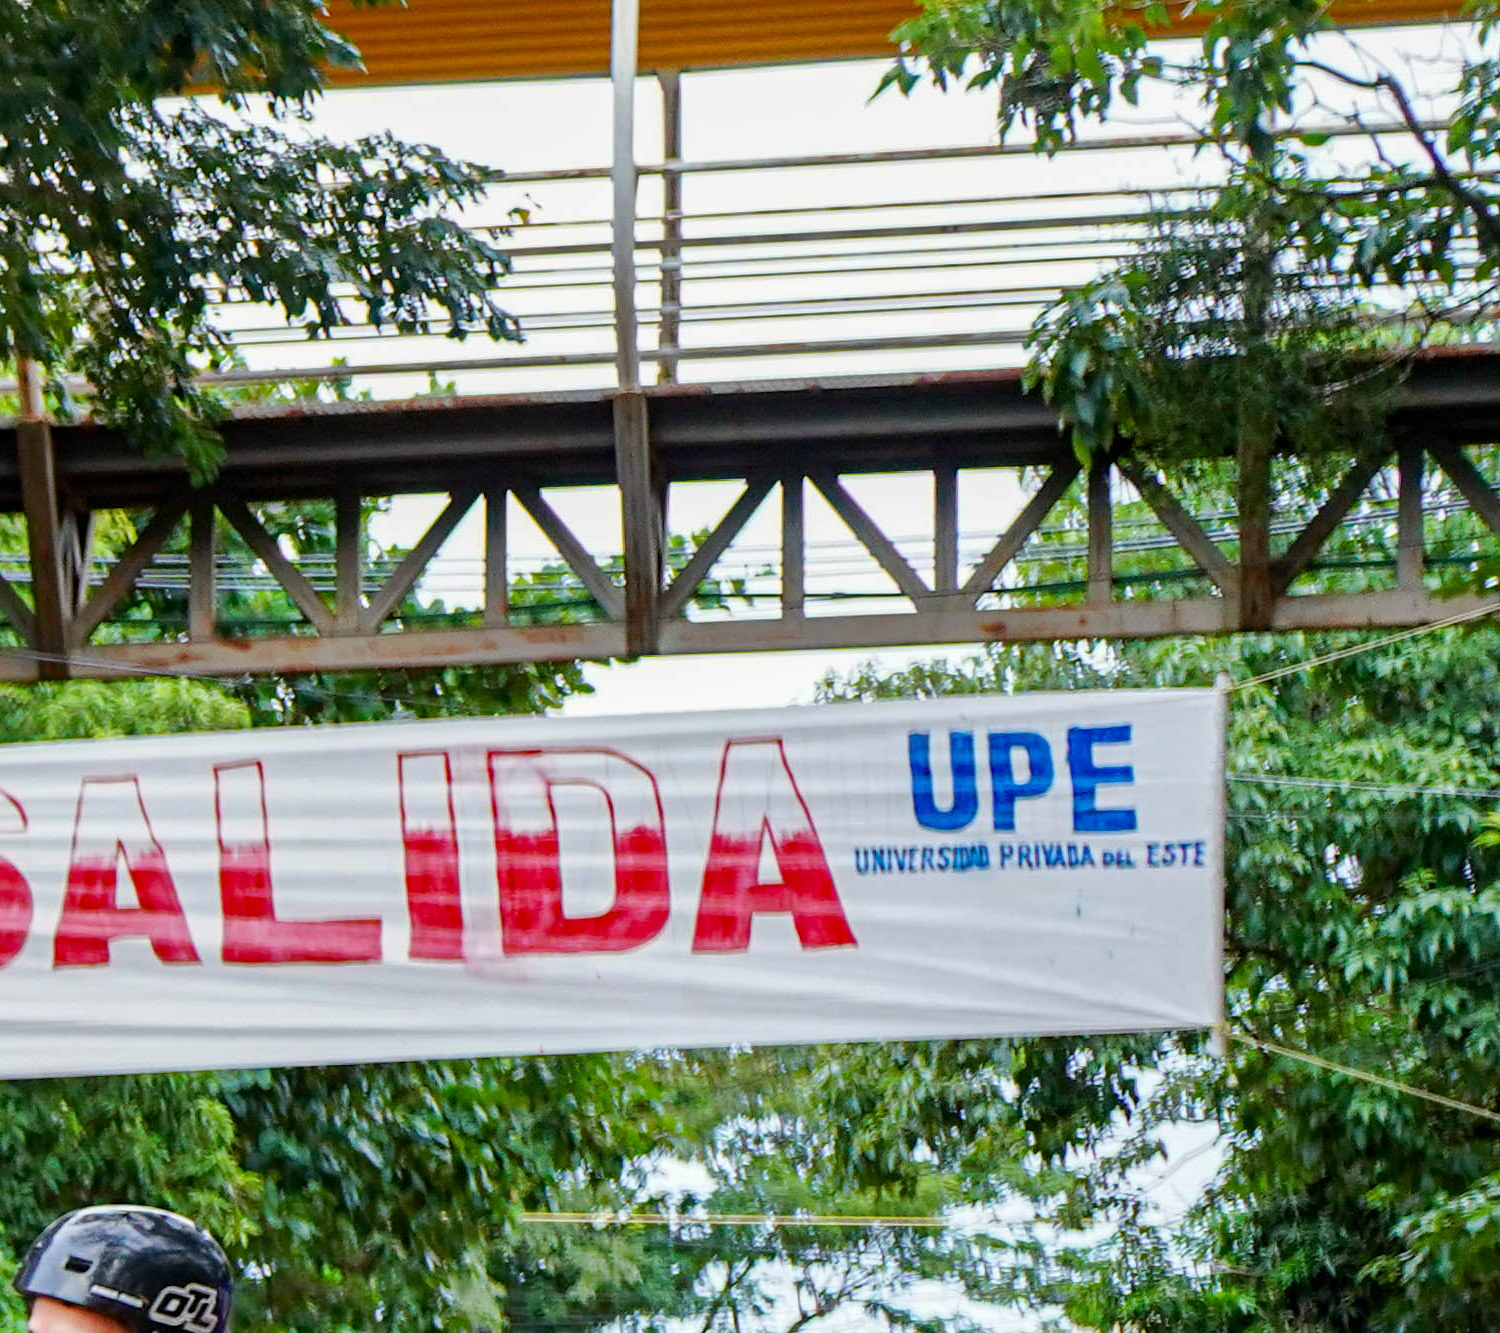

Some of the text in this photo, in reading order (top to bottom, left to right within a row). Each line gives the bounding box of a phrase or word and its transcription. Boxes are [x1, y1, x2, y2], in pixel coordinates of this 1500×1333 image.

[908, 724, 1138, 833] UPE
[854, 842, 1206, 876] UNIVERSIDAD PRIVADA DEL ESTE
